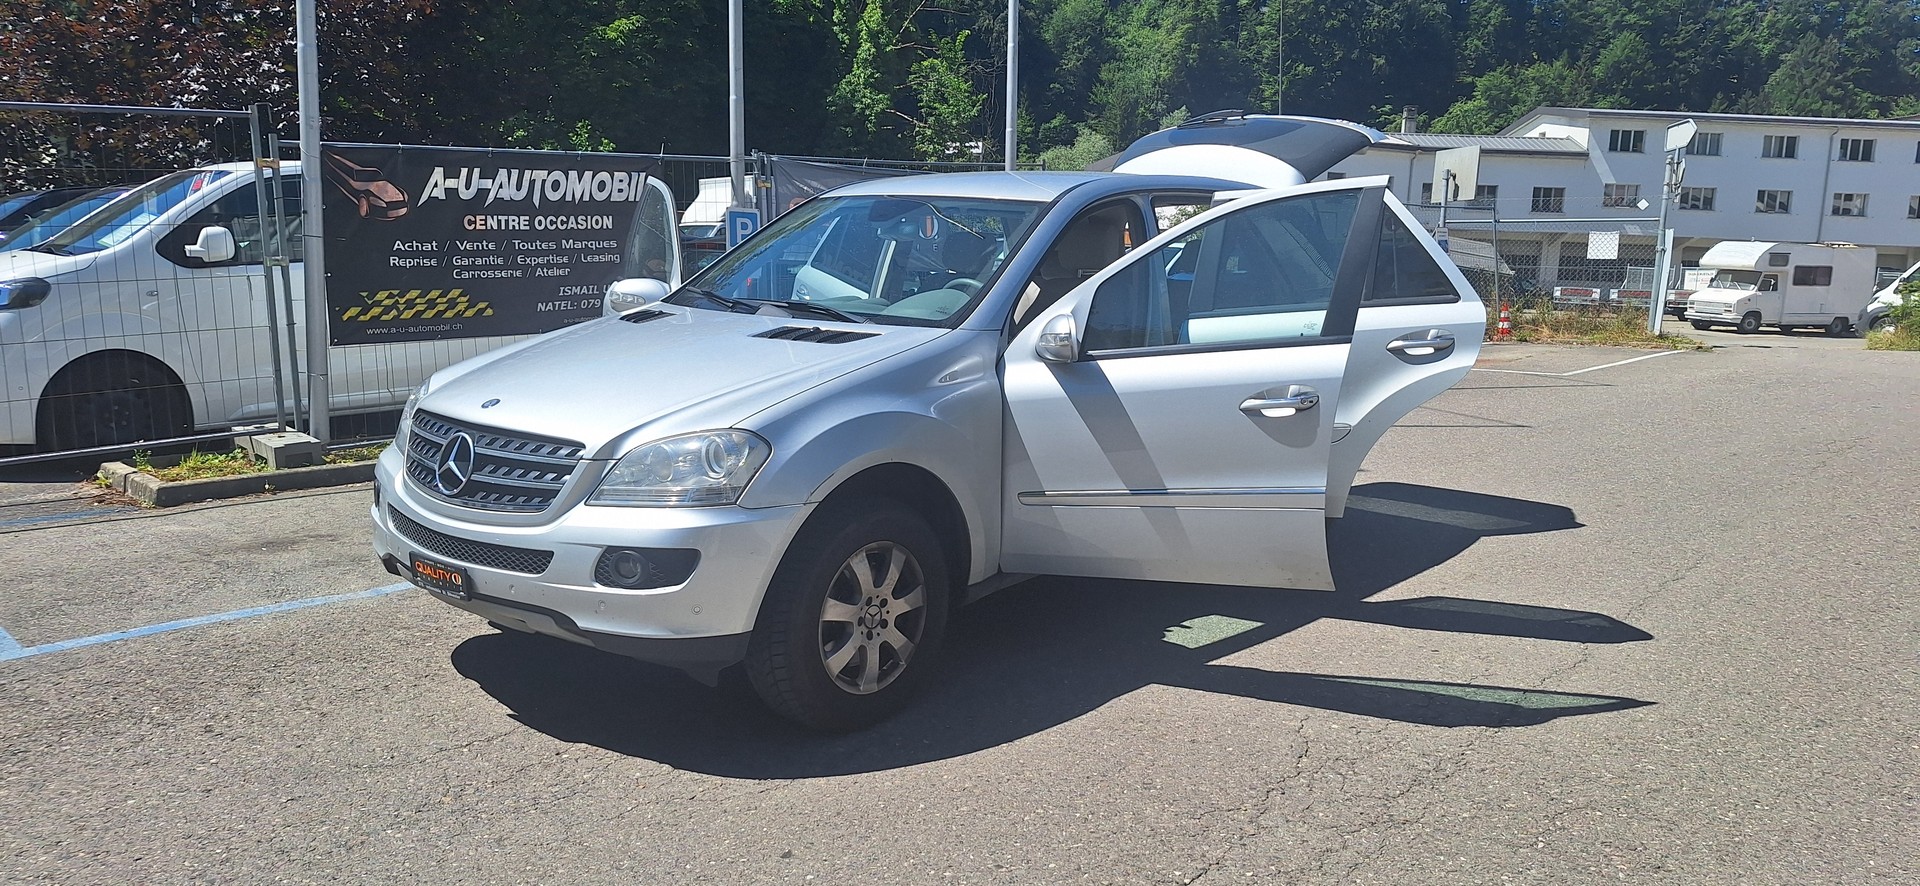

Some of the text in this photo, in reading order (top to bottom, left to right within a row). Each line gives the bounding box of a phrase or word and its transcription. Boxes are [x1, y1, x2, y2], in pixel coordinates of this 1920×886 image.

[464, 215, 613, 231] CENTRE OCCASION
[736, 217, 753, 243] P
[393, 241, 438, 251] Achat
[456, 240, 496, 251] Vente
[512, 239, 556, 250] Toutes
[561, 239, 618, 251] Marques
[389, 256, 438, 268] Reprise
[452, 255, 504, 266] Garantie
[517, 254, 569, 267] Expertise
[581, 252, 620, 264] Leasing
[453, 268, 523, 279] Carrosserie
[535, 266, 571, 277] Atelier
[558, 285, 600, 296] ISMAIL
[537, 299, 601, 312] NATEL: 079
[366, 322, 463, 335] www.a-u-automobil.ch
[415, 561, 451, 582] QUALITY
